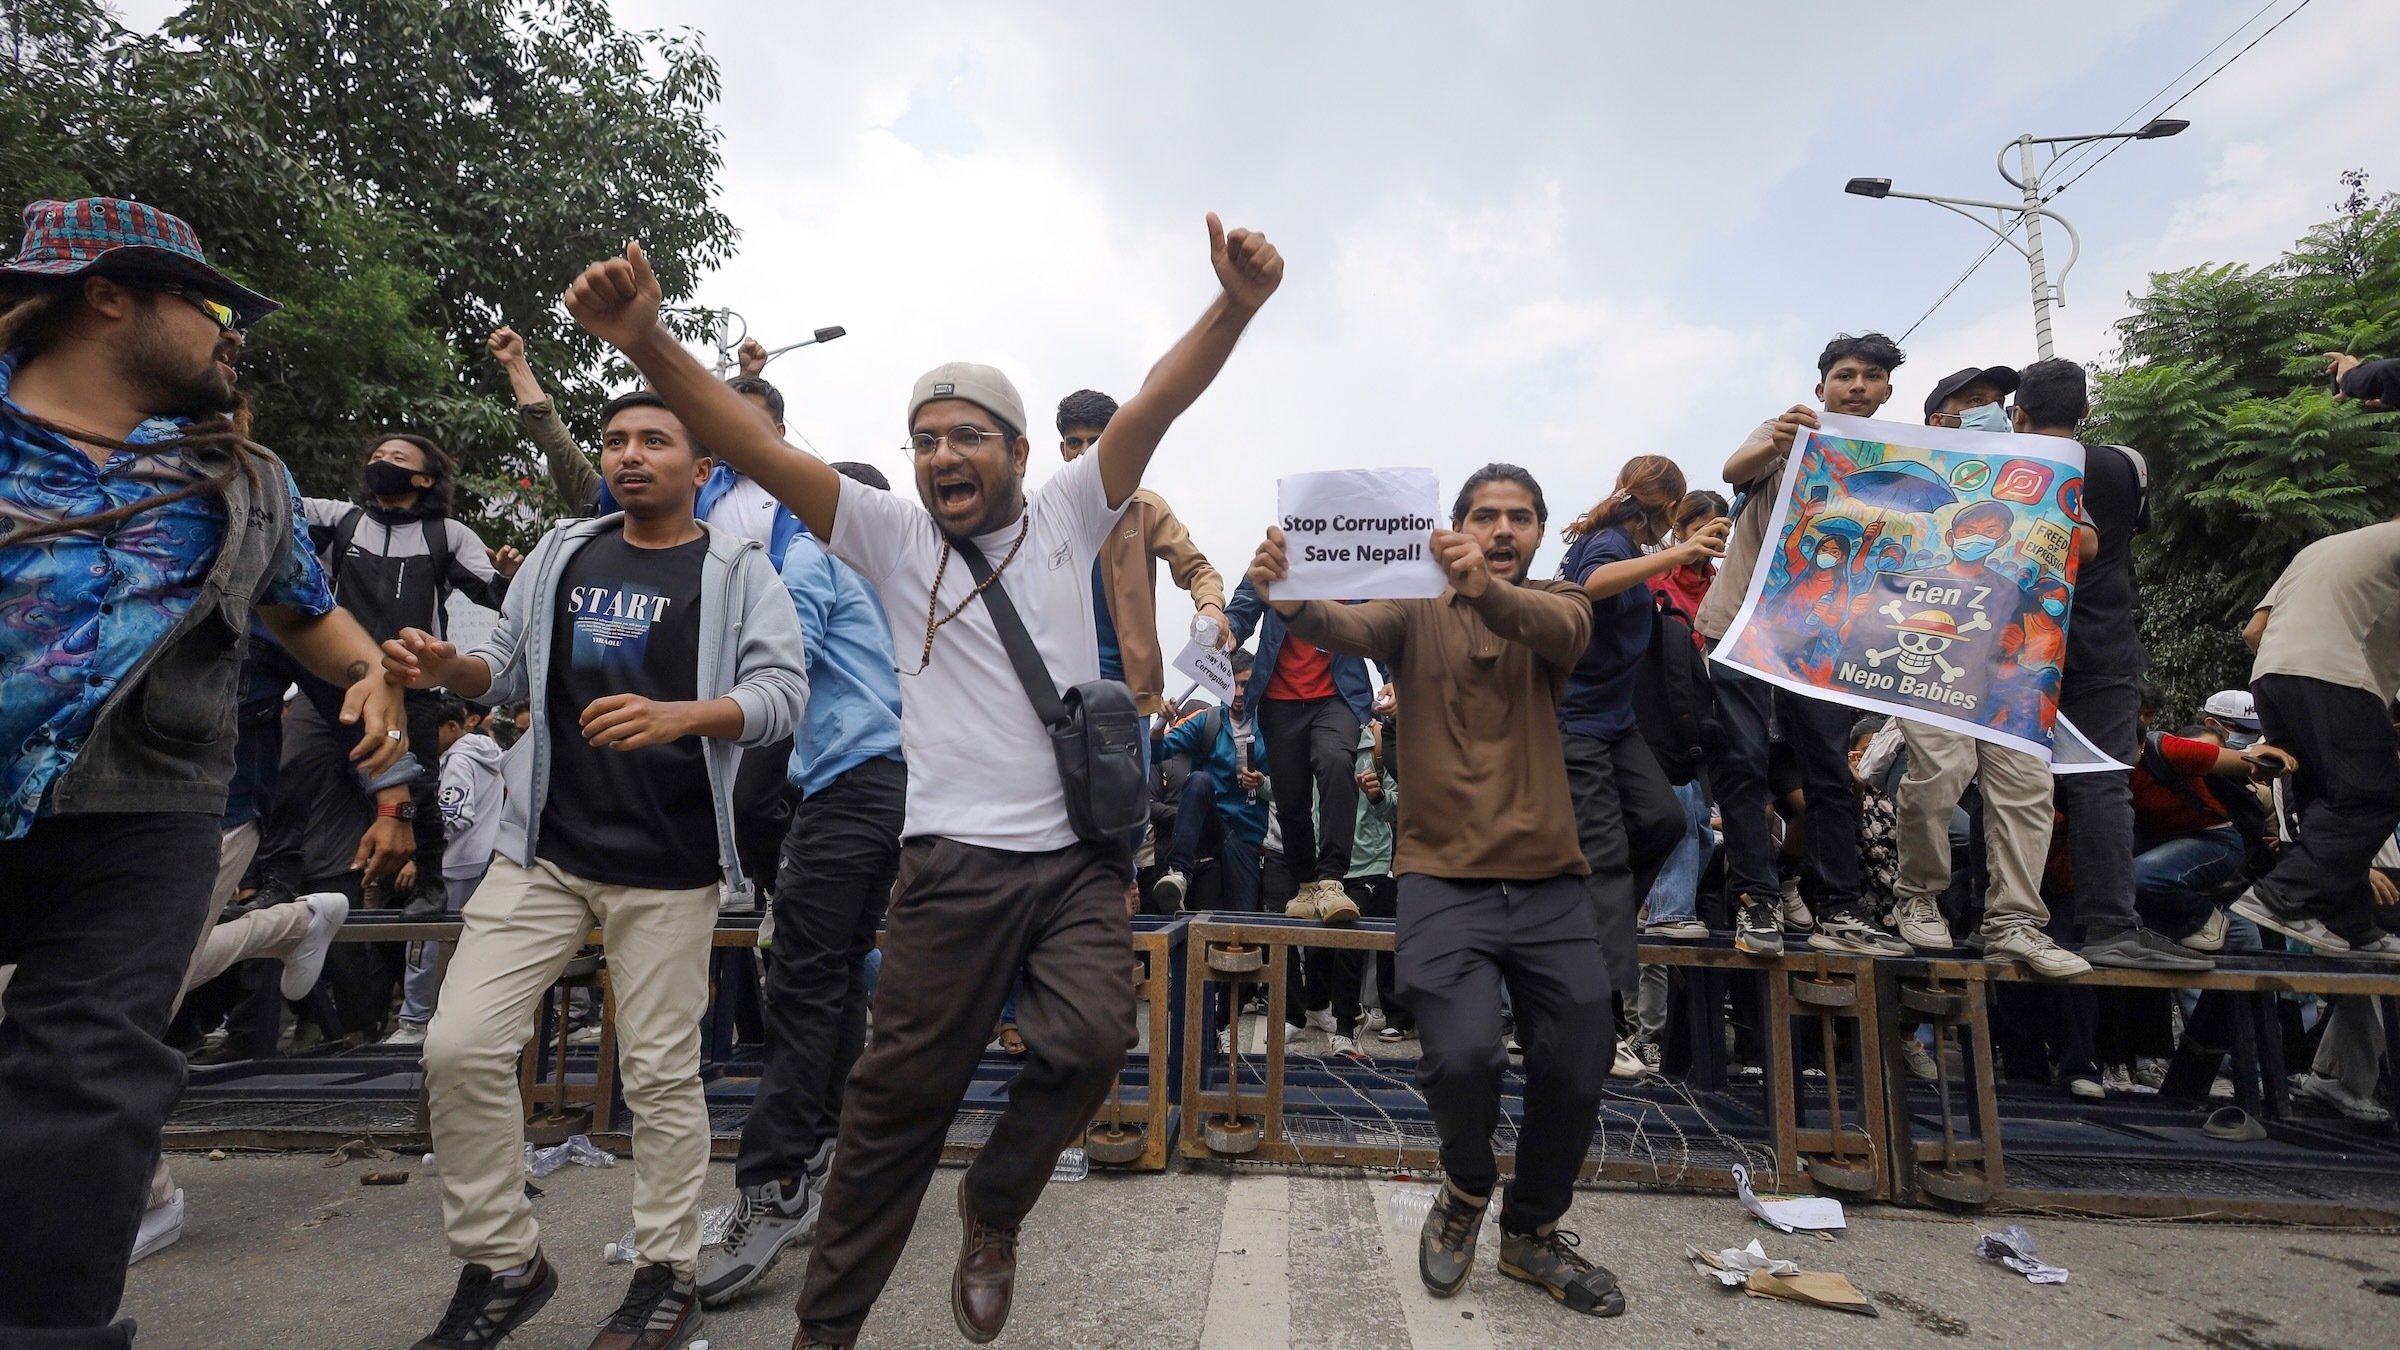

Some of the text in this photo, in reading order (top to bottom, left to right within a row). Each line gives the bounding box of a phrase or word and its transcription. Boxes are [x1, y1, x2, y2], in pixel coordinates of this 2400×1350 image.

[1283, 514, 1434, 535] Stop Corruption
[2036, 525, 2070, 552] FREED
[2048, 543, 2059, 553] OF
[1305, 544, 1421, 564] Save Nepal!
[567, 585, 671, 622] START
[1906, 581, 1992, 610] Gen Z
[1195, 660, 1230, 690] Corruption!
[1217, 661, 1227, 673] No
[1838, 662, 1978, 710] Nepo Babies
